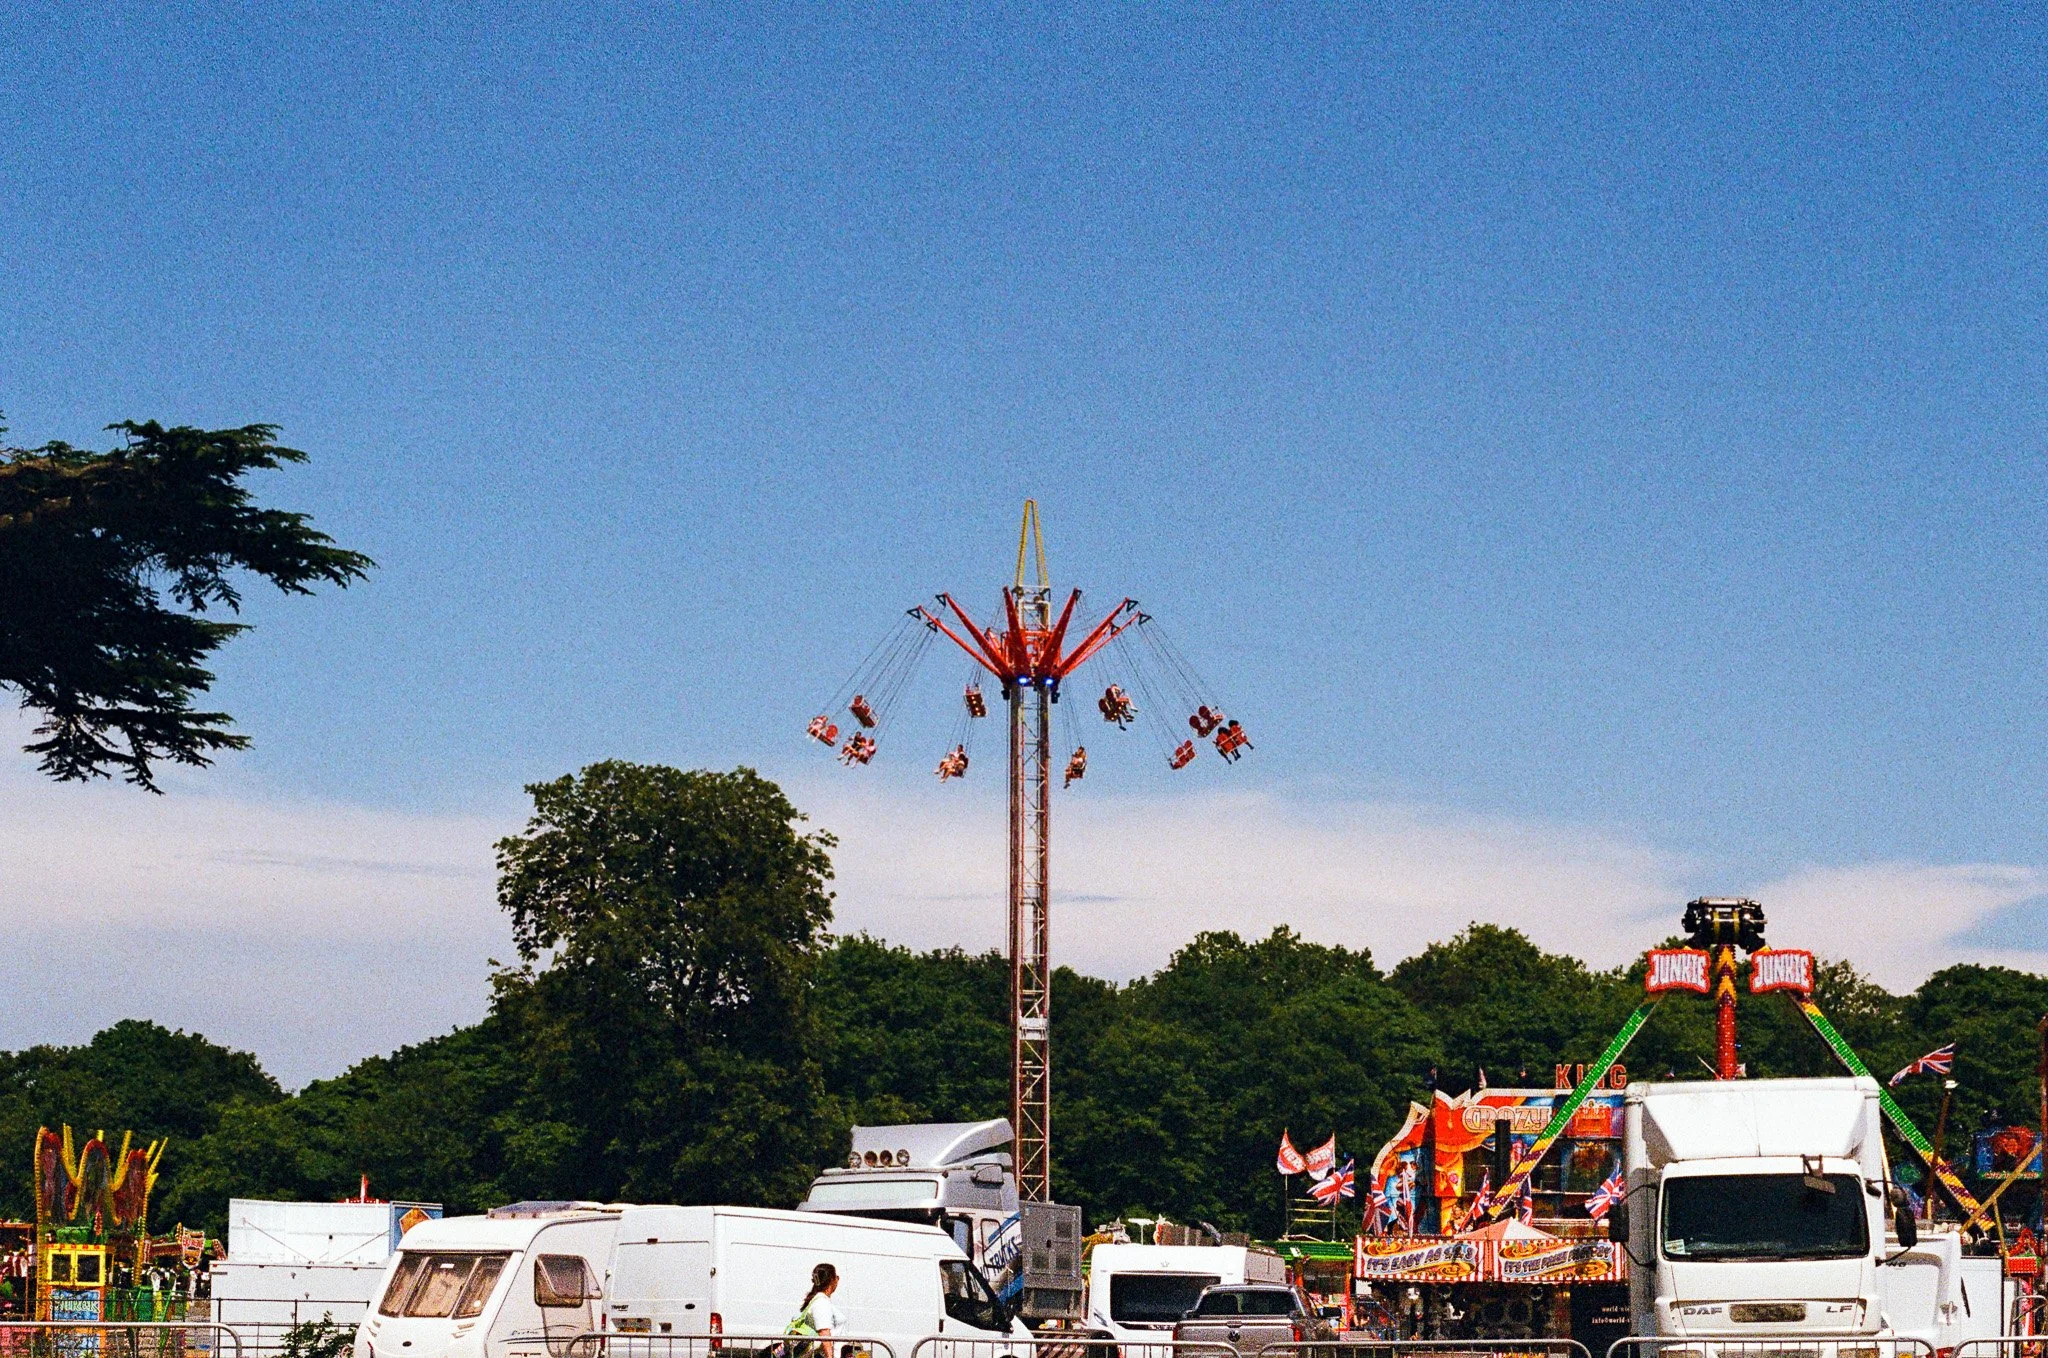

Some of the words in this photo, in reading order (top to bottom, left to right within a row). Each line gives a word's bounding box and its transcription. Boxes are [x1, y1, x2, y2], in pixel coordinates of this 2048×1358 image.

[1650, 953, 1707, 990] JUNKIE
[1753, 953, 1811, 990] JUNKIE
[1683, 1306, 1723, 1316] DAF
[1825, 1304, 1853, 1313] LF
